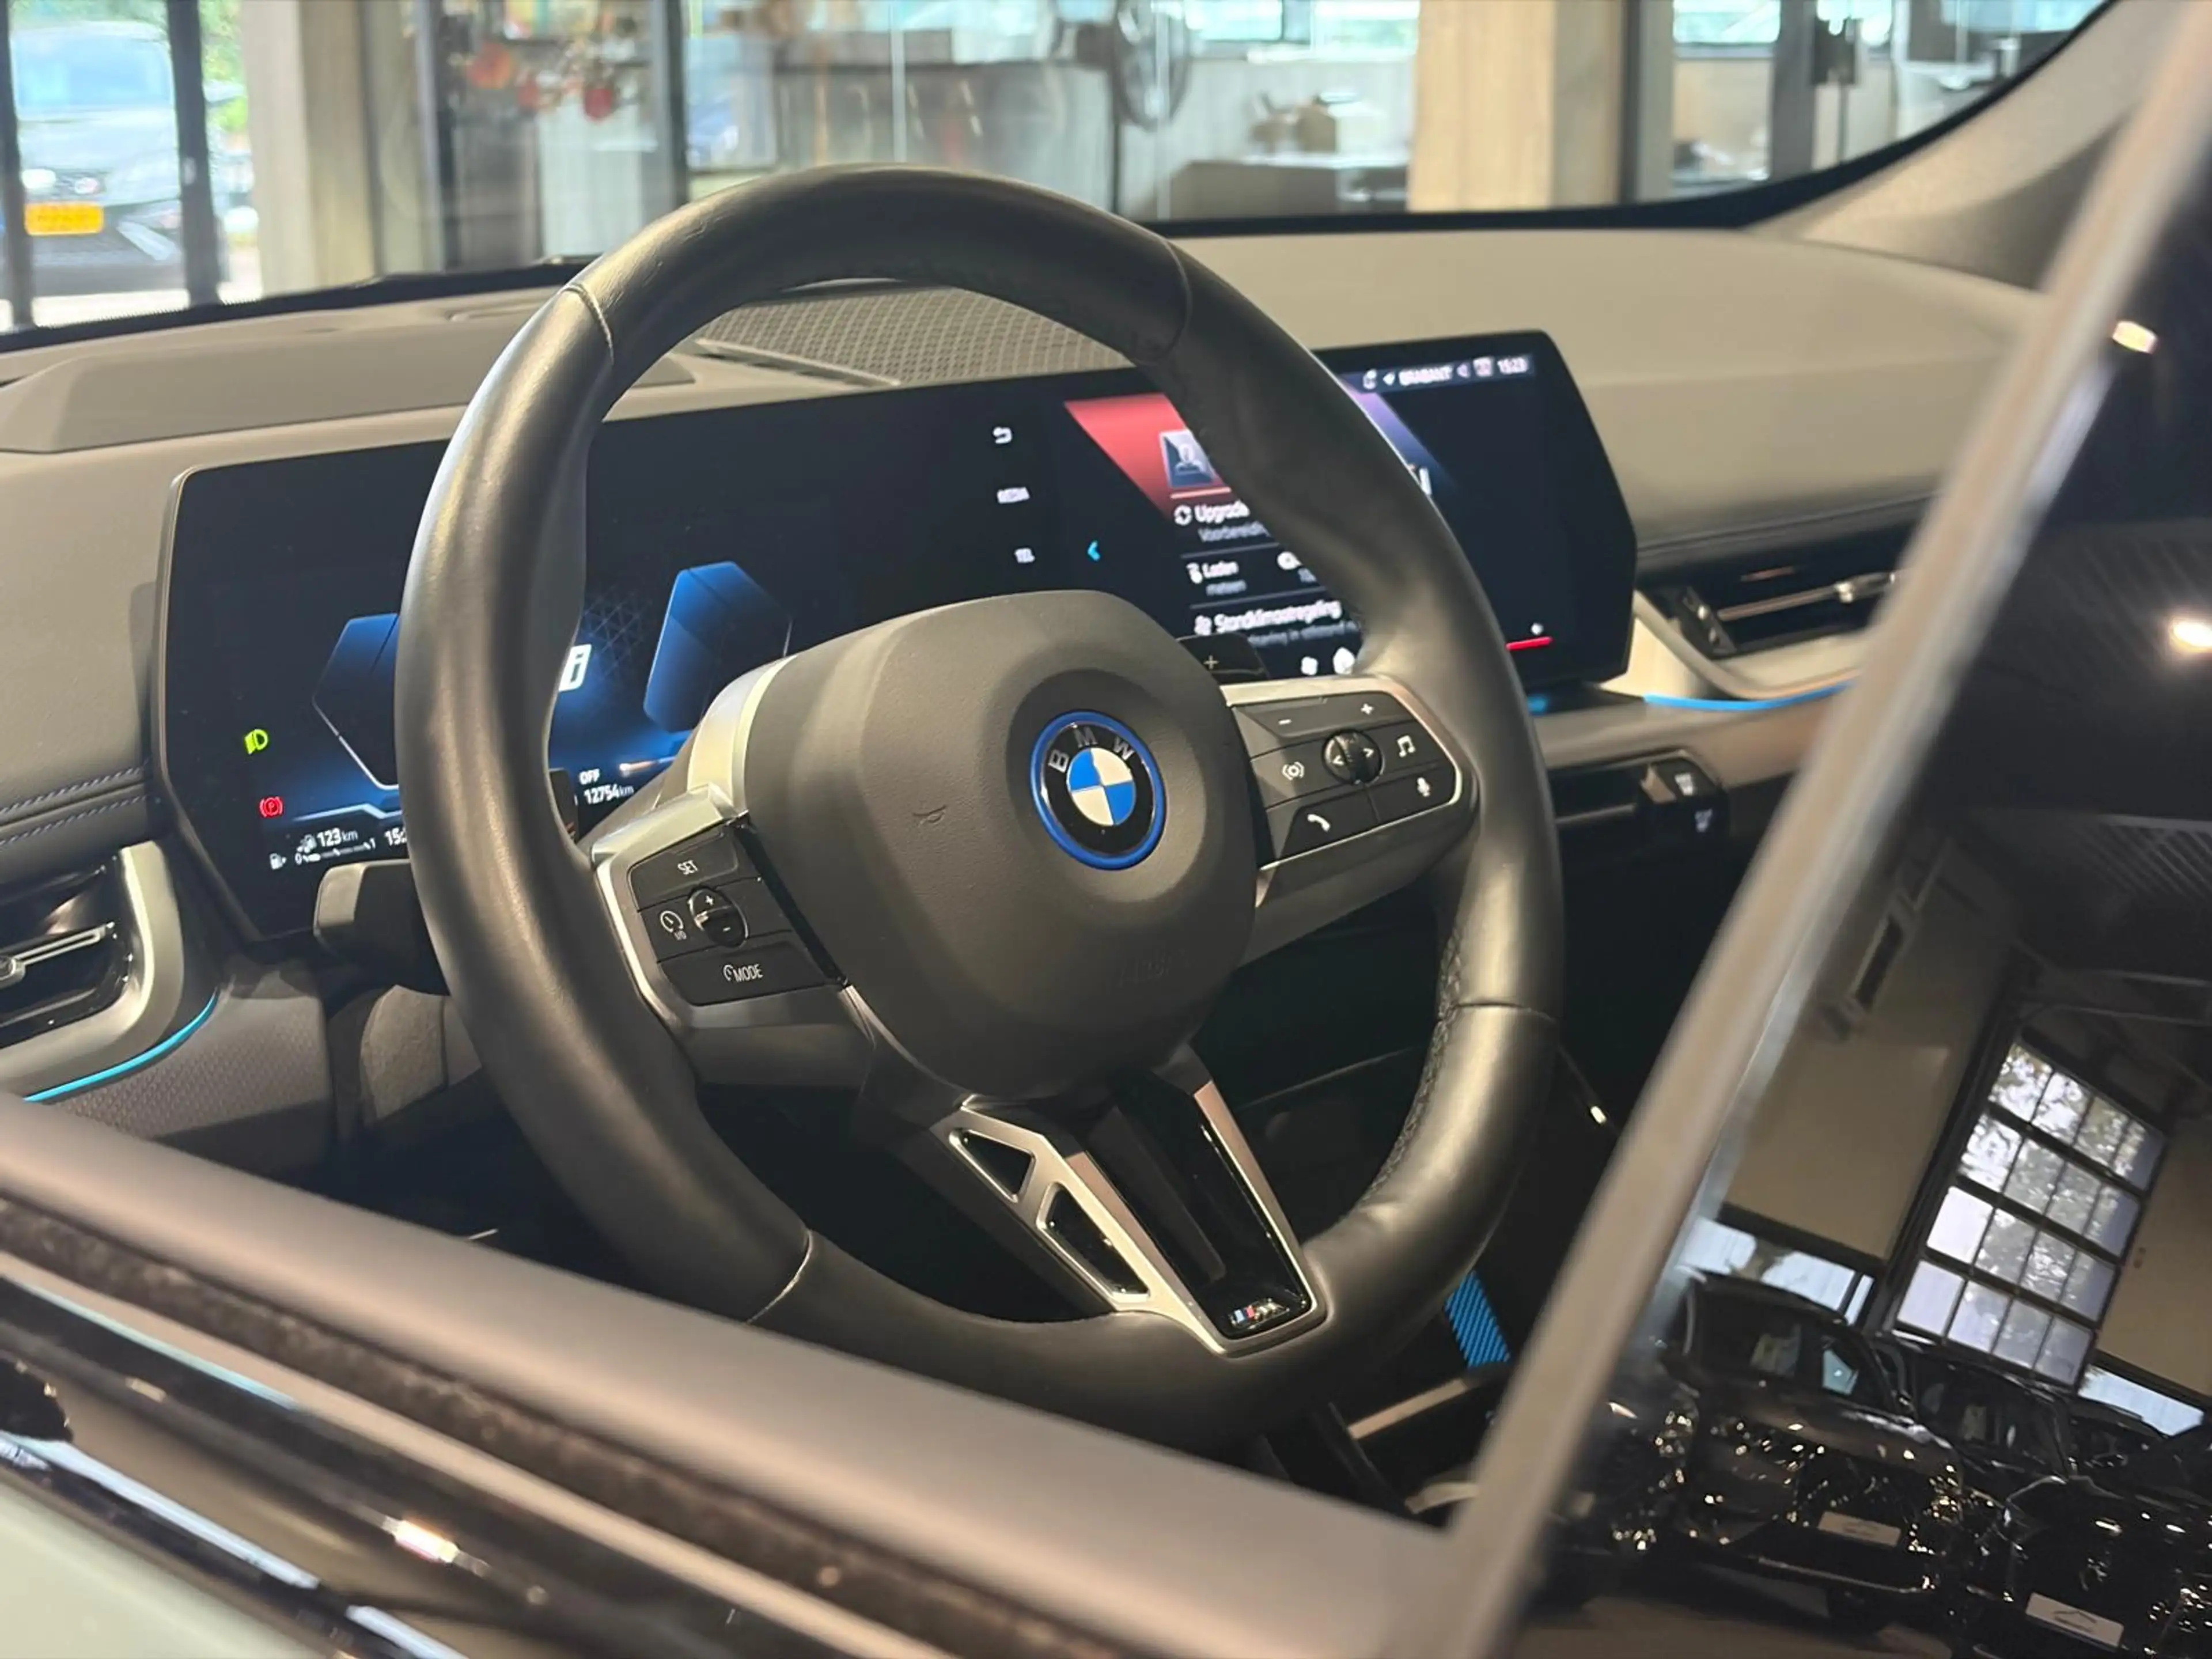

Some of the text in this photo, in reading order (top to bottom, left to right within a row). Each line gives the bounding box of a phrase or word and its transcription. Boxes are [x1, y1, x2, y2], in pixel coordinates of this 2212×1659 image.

[1048, 726, 1136, 773] BMW
[677, 859, 699, 876] SET
[732, 964, 764, 982] MODE
